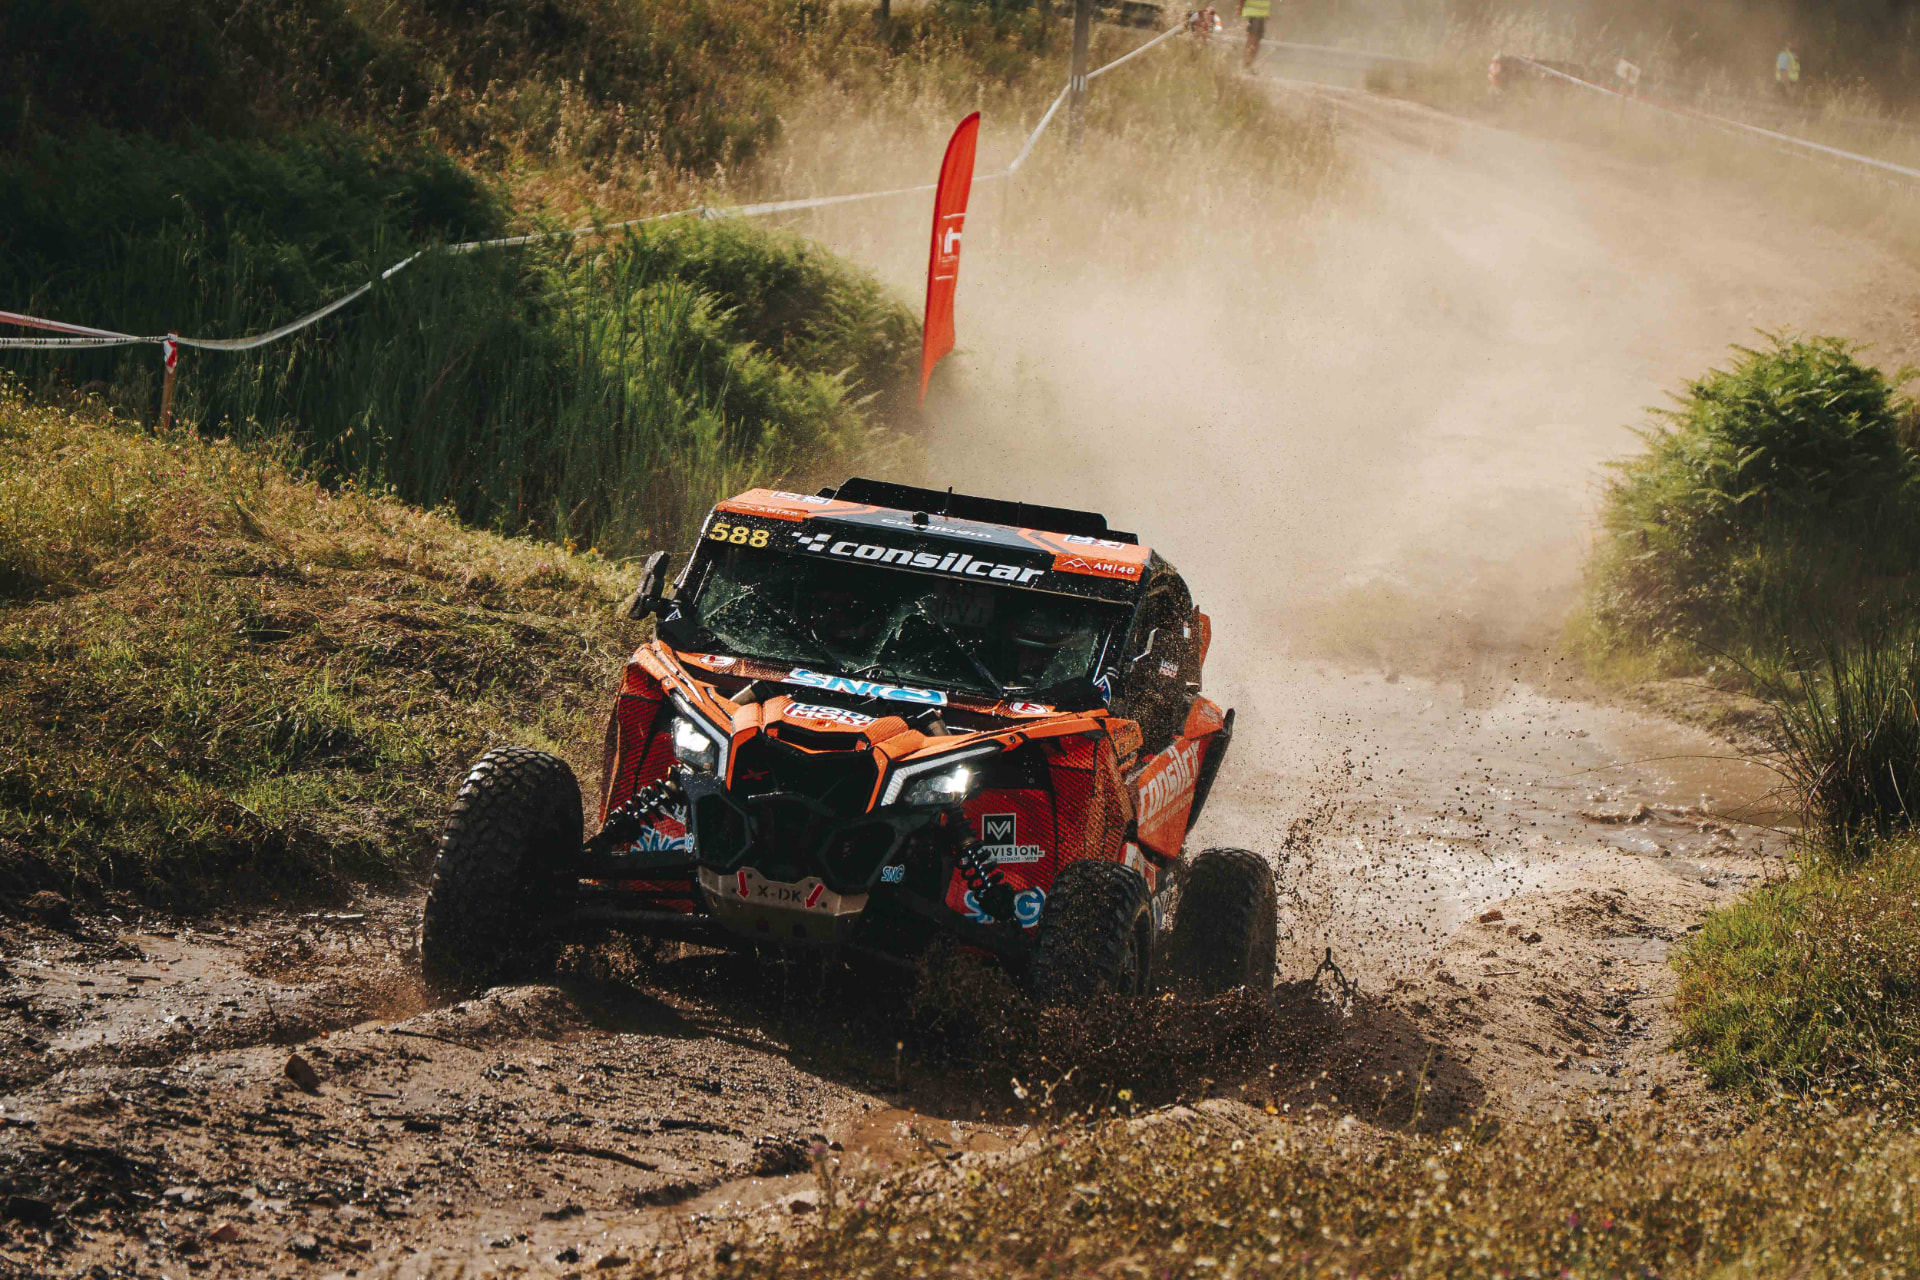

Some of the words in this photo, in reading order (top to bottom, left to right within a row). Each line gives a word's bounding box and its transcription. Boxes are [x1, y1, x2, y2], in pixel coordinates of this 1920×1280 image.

[708, 522, 770, 548] 588
[829, 539, 1046, 583] consilcar
[787, 709, 870, 727] MOLY
[982, 845, 1038, 857] VISION
[881, 864, 905, 883] SNG
[757, 884, 802, 903] X-DK
[963, 886, 1047, 928] SG
